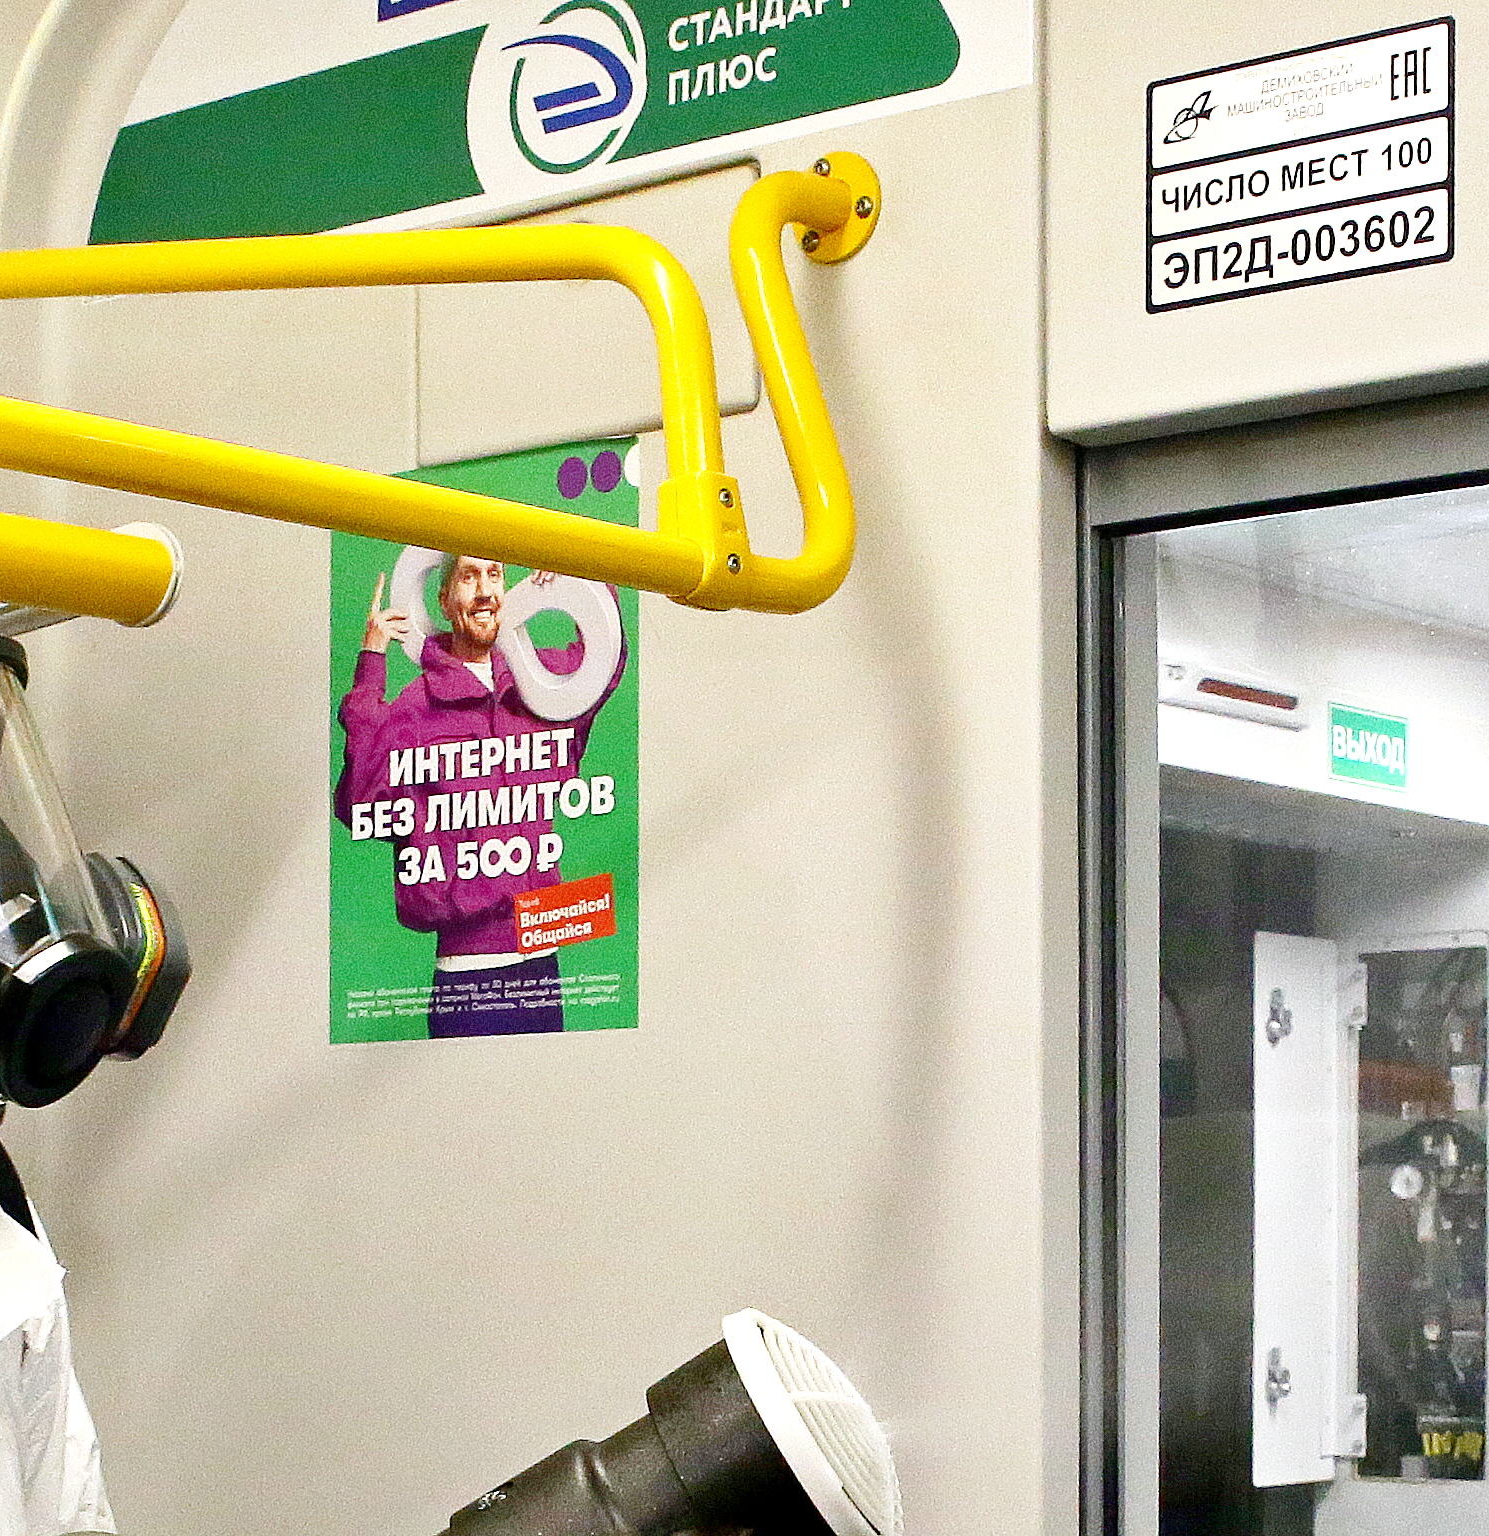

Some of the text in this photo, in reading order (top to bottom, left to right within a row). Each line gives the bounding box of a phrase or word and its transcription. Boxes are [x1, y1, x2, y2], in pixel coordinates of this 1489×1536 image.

[667, 0, 853, 52] СТАНДА
[667, 46, 778, 106] ПЛЮС
[1226, 72, 1384, 118] МАШИНОСТРОИТЕЛЬНЫЙ
[1284, 102, 1325, 123] ЗАВОД
[1161, 137, 1432, 213] ЧИСЛО МЕСТ 100
[1163, 205, 1436, 289] ЭП2Д-003602
[389, 727, 575, 788] ИНТЕРНЕТ
[1332, 724, 1406, 775] ВЫХОД
[351, 775, 616, 841] БЕЗ ЛИМИТОВ
[398, 845, 447, 886] ЗА
[519, 892, 611, 929] Включайся!
[521, 921, 593, 948] Общайся
